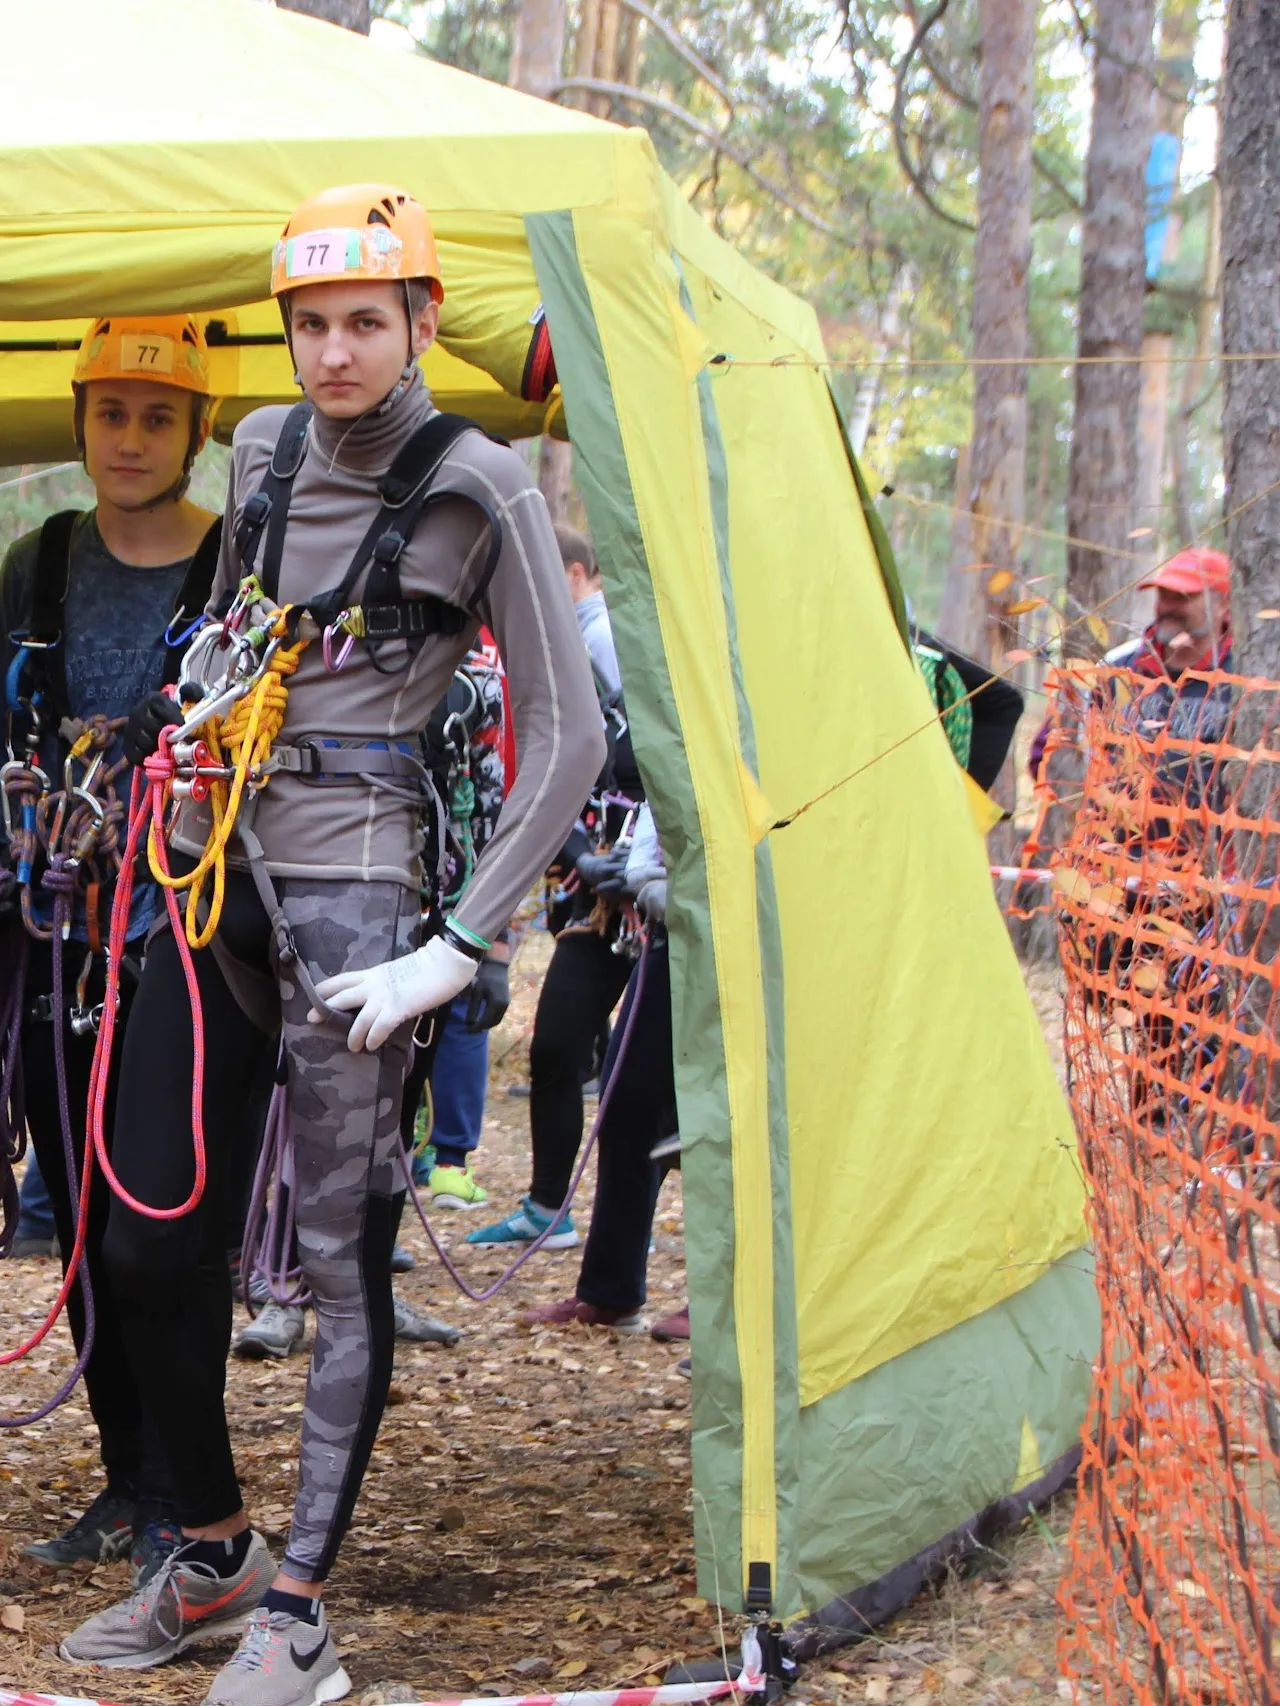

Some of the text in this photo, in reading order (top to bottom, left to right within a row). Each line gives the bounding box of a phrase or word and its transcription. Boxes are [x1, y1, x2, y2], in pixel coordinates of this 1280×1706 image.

[307, 244, 330, 267] 77
[138, 345, 160, 364] 77
[66, 649, 166, 682] RIGINA
